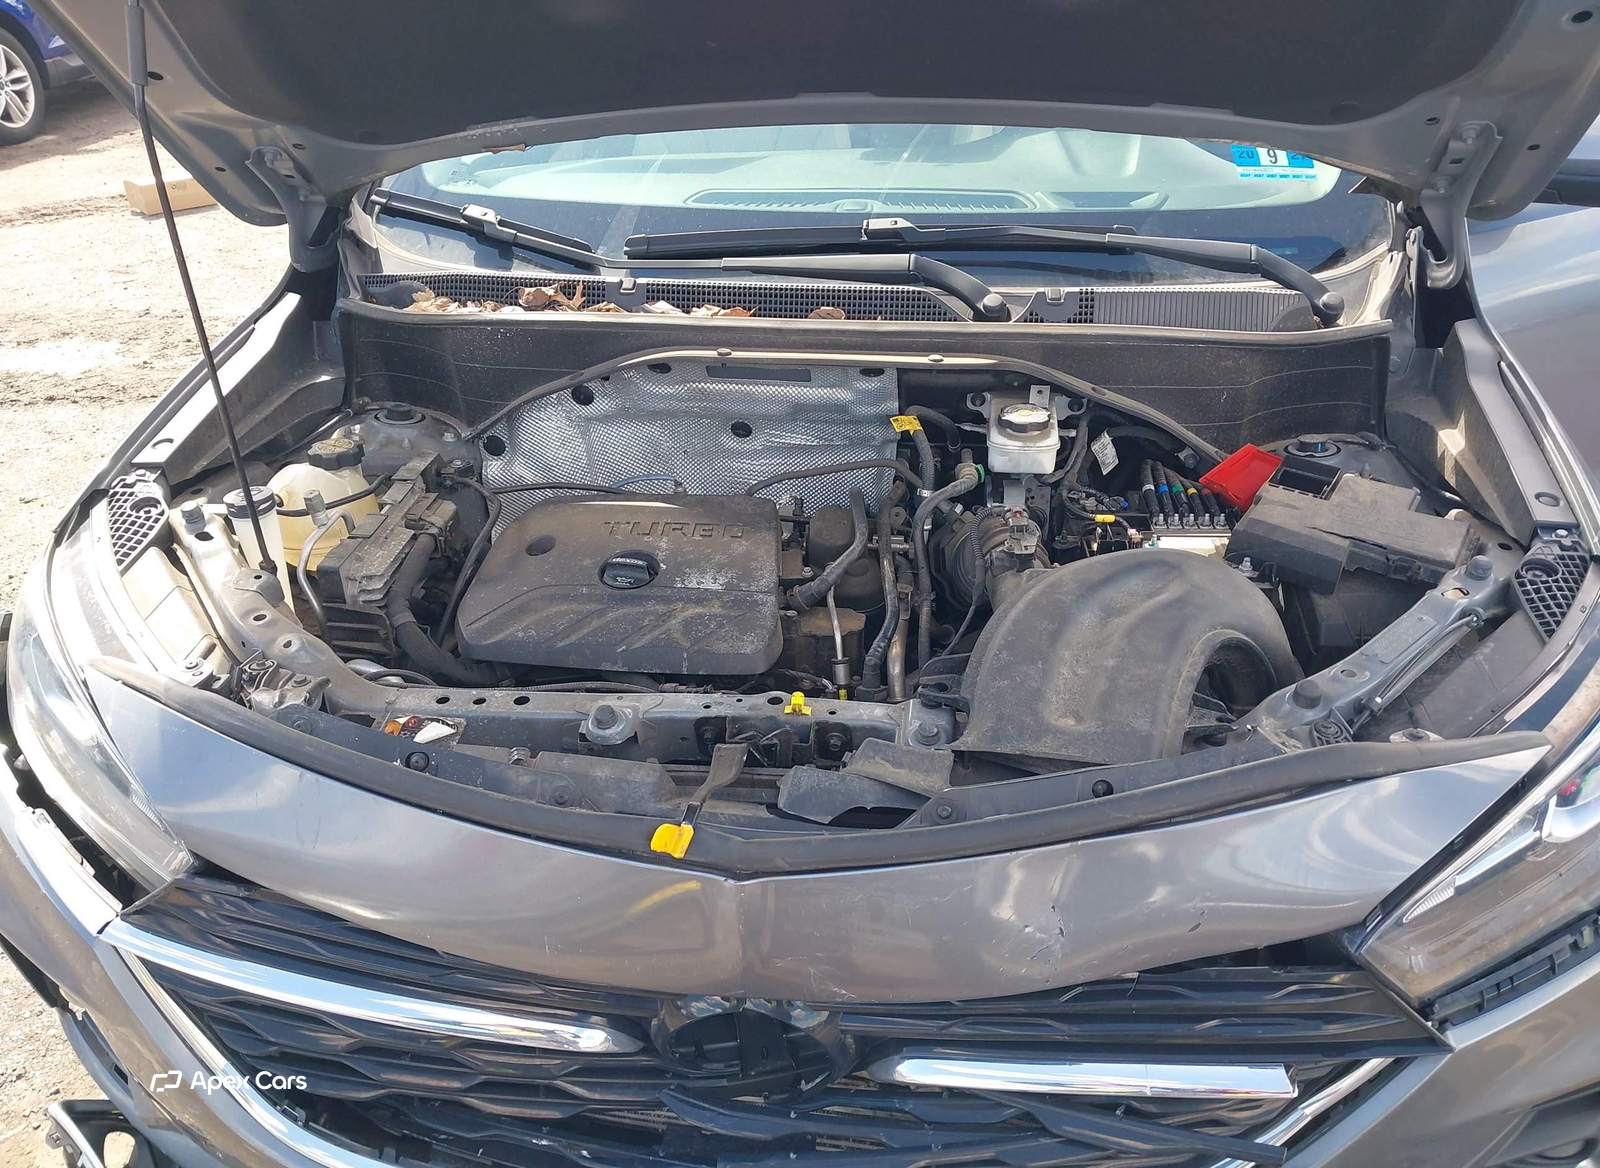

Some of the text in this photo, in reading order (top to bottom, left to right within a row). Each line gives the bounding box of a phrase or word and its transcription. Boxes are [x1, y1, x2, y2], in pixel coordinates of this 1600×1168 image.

[1267, 148, 1278, 164] 9
[604, 520, 755, 539] TURBO
[612, 557, 644, 566] dexos
